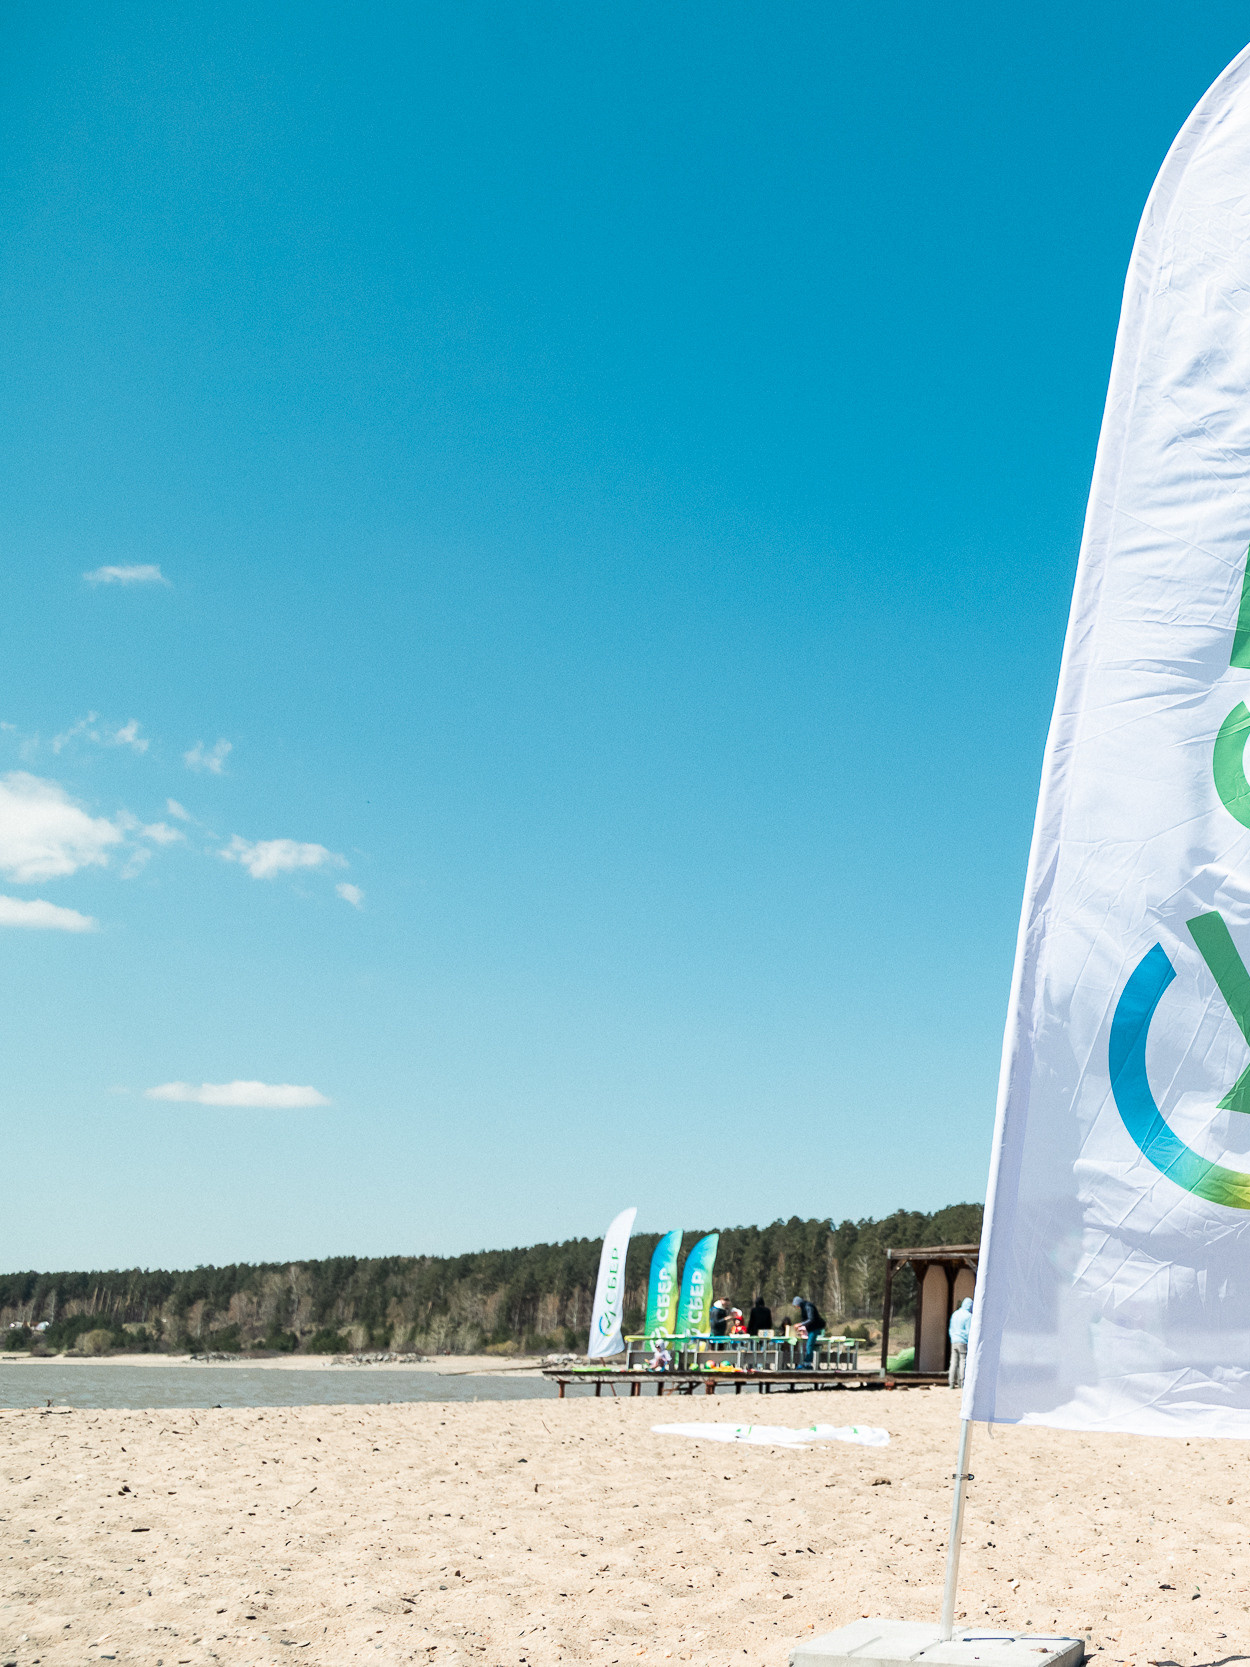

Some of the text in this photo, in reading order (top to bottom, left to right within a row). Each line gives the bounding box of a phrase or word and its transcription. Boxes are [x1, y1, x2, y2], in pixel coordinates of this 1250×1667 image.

[606, 1248, 618, 1305] СБЕР
[657, 1268, 672, 1322] СБЕР
[689, 1271, 704, 1323] СБЕР
